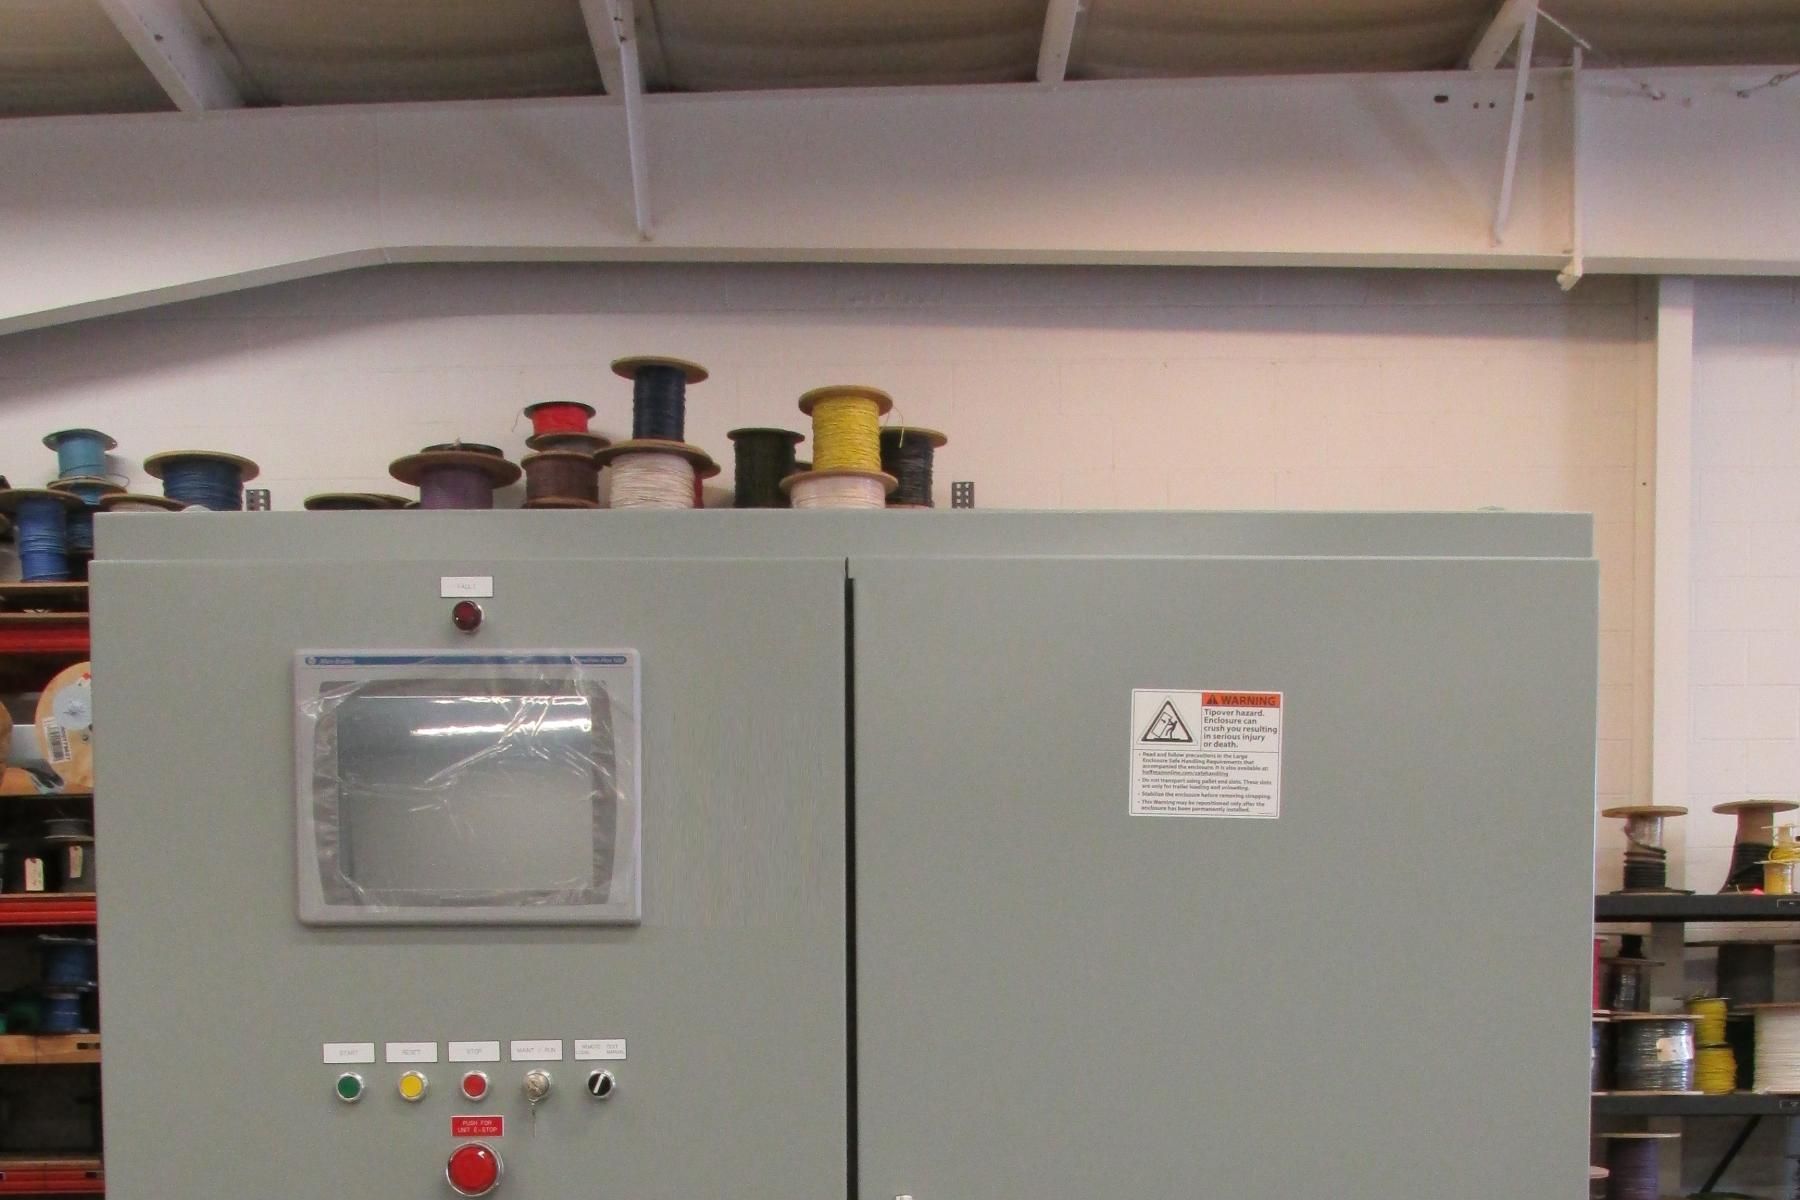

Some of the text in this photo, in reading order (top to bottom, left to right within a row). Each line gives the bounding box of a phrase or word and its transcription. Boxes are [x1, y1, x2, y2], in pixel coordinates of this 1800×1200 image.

[1222, 695, 1276, 706] WARNING
[1204, 708, 1265, 718] Tipover hazard.
[1203, 717, 1242, 725] Enclosure
[1226, 726, 1241, 734] you
[1243, 726, 1278, 734] resulting
[1242, 734, 1265, 742] injury
[1213, 740, 1238, 748] death.
[338, 1049, 359, 1057] START
